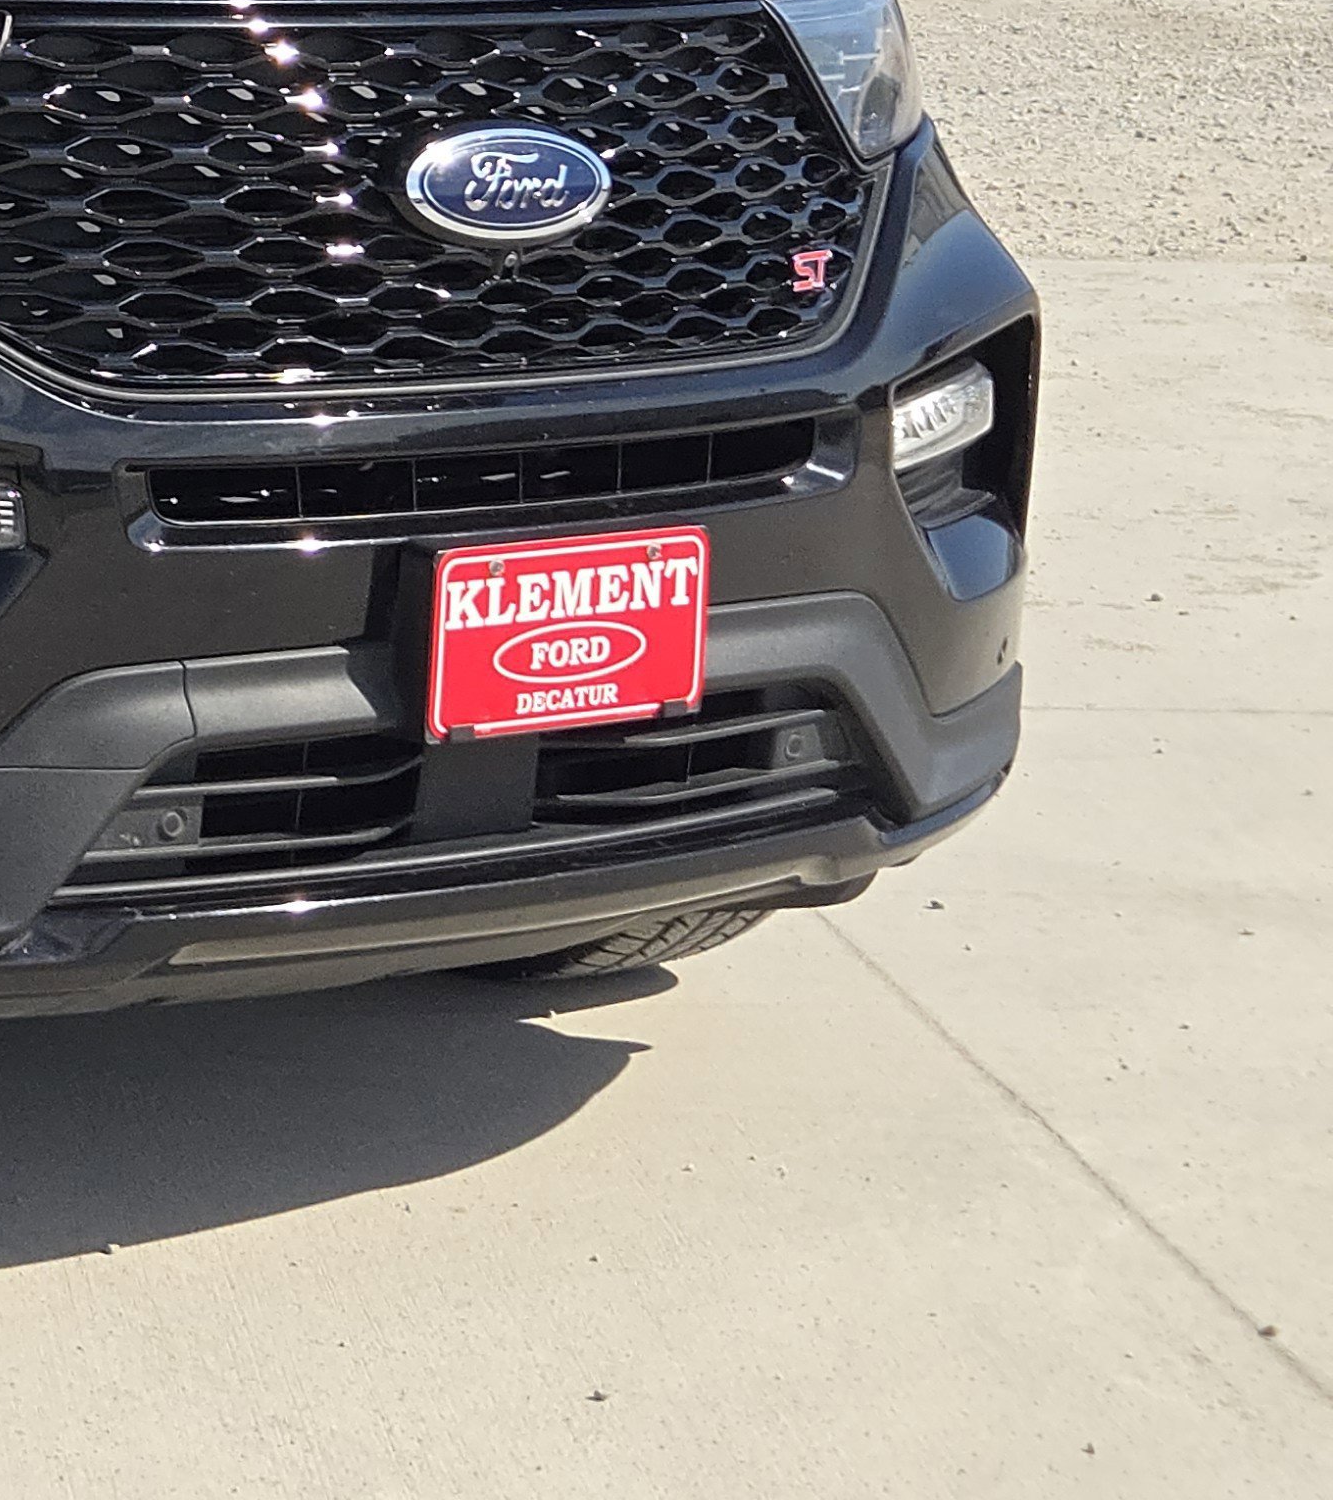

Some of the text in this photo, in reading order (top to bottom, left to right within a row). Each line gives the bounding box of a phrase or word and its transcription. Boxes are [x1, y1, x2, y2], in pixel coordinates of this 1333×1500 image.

[464, 151, 570, 212] Ford
[792, 249, 833, 292] ST
[444, 556, 699, 630] KLEMENT
[530, 635, 611, 670] FORD
[516, 683, 619, 714] DECATUR
